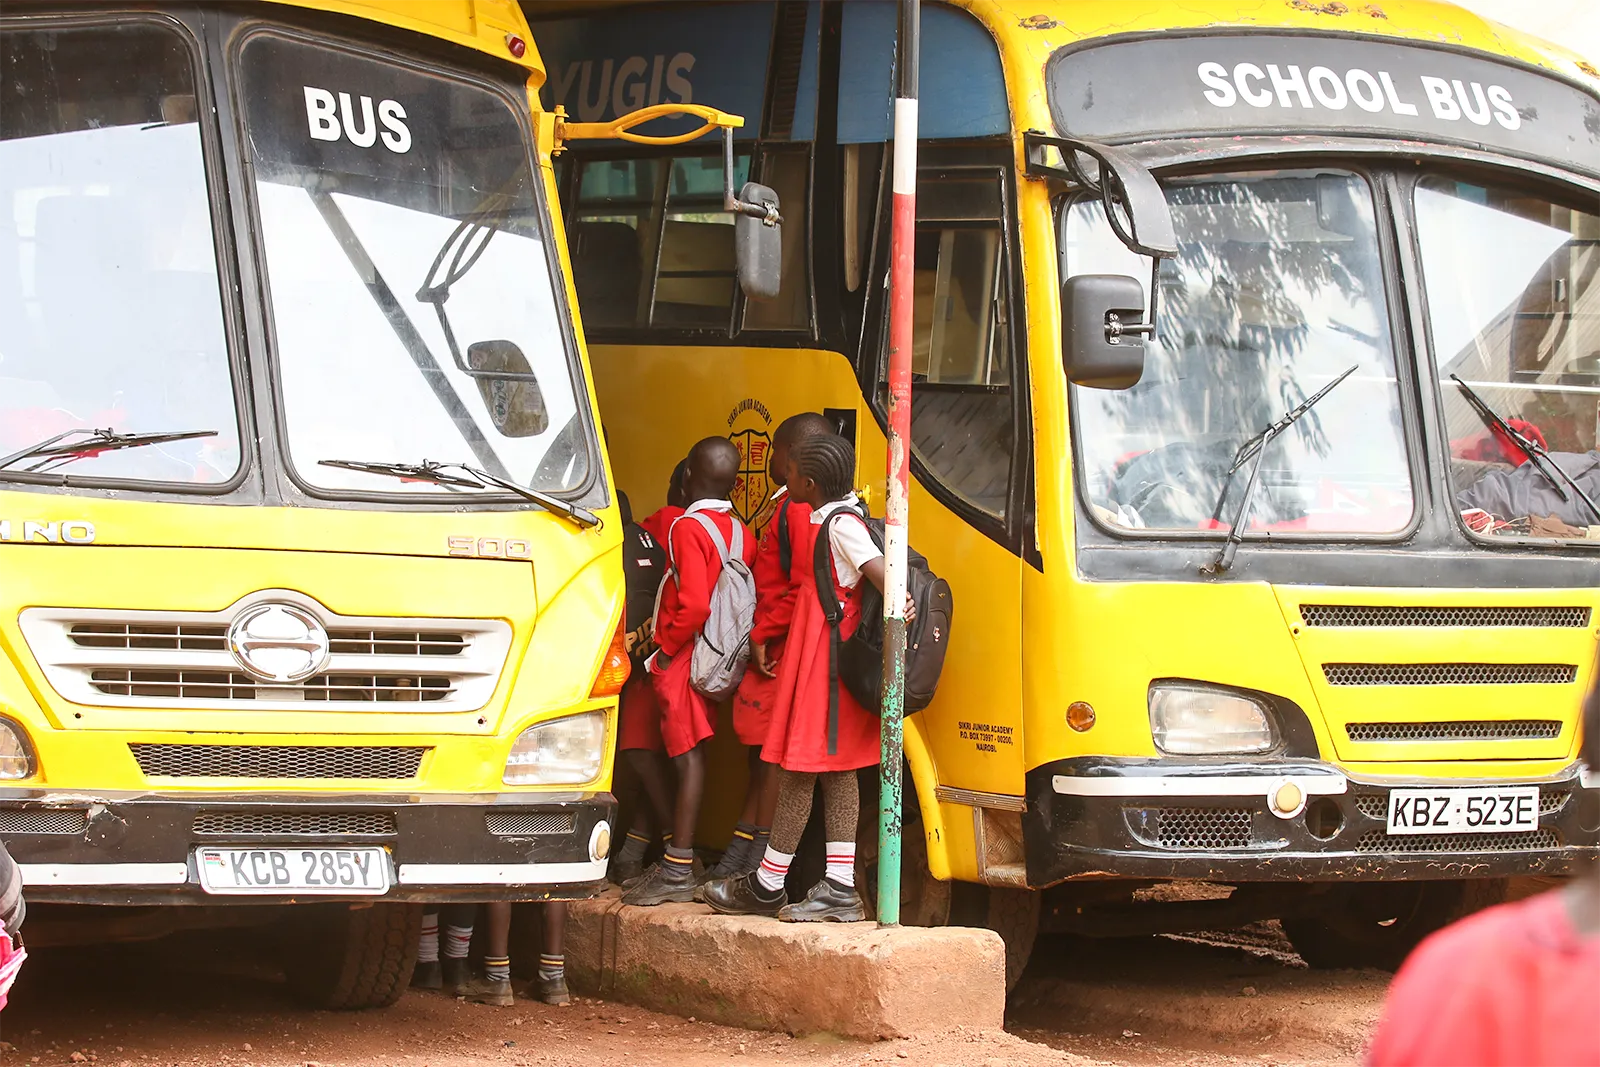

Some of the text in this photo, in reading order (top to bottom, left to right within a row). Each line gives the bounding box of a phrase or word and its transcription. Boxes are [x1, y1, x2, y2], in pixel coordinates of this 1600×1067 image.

[541, 52, 696, 122] YUGIS
[1197, 61, 1521, 131] SCHOOL BUS
[303, 86, 412, 154] BUS
[738, 398, 753, 414] JUNIOR
[753, 399, 772, 426] ACADEMY
[447, 536, 531, 558] 500
[958, 721, 1013, 735] SIKRI JUNIOR ACADEMY
[969, 732, 979, 741] BOX
[1392, 795, 1533, 827] KBZ 523E
[230, 852, 371, 886] KCB 285Y
